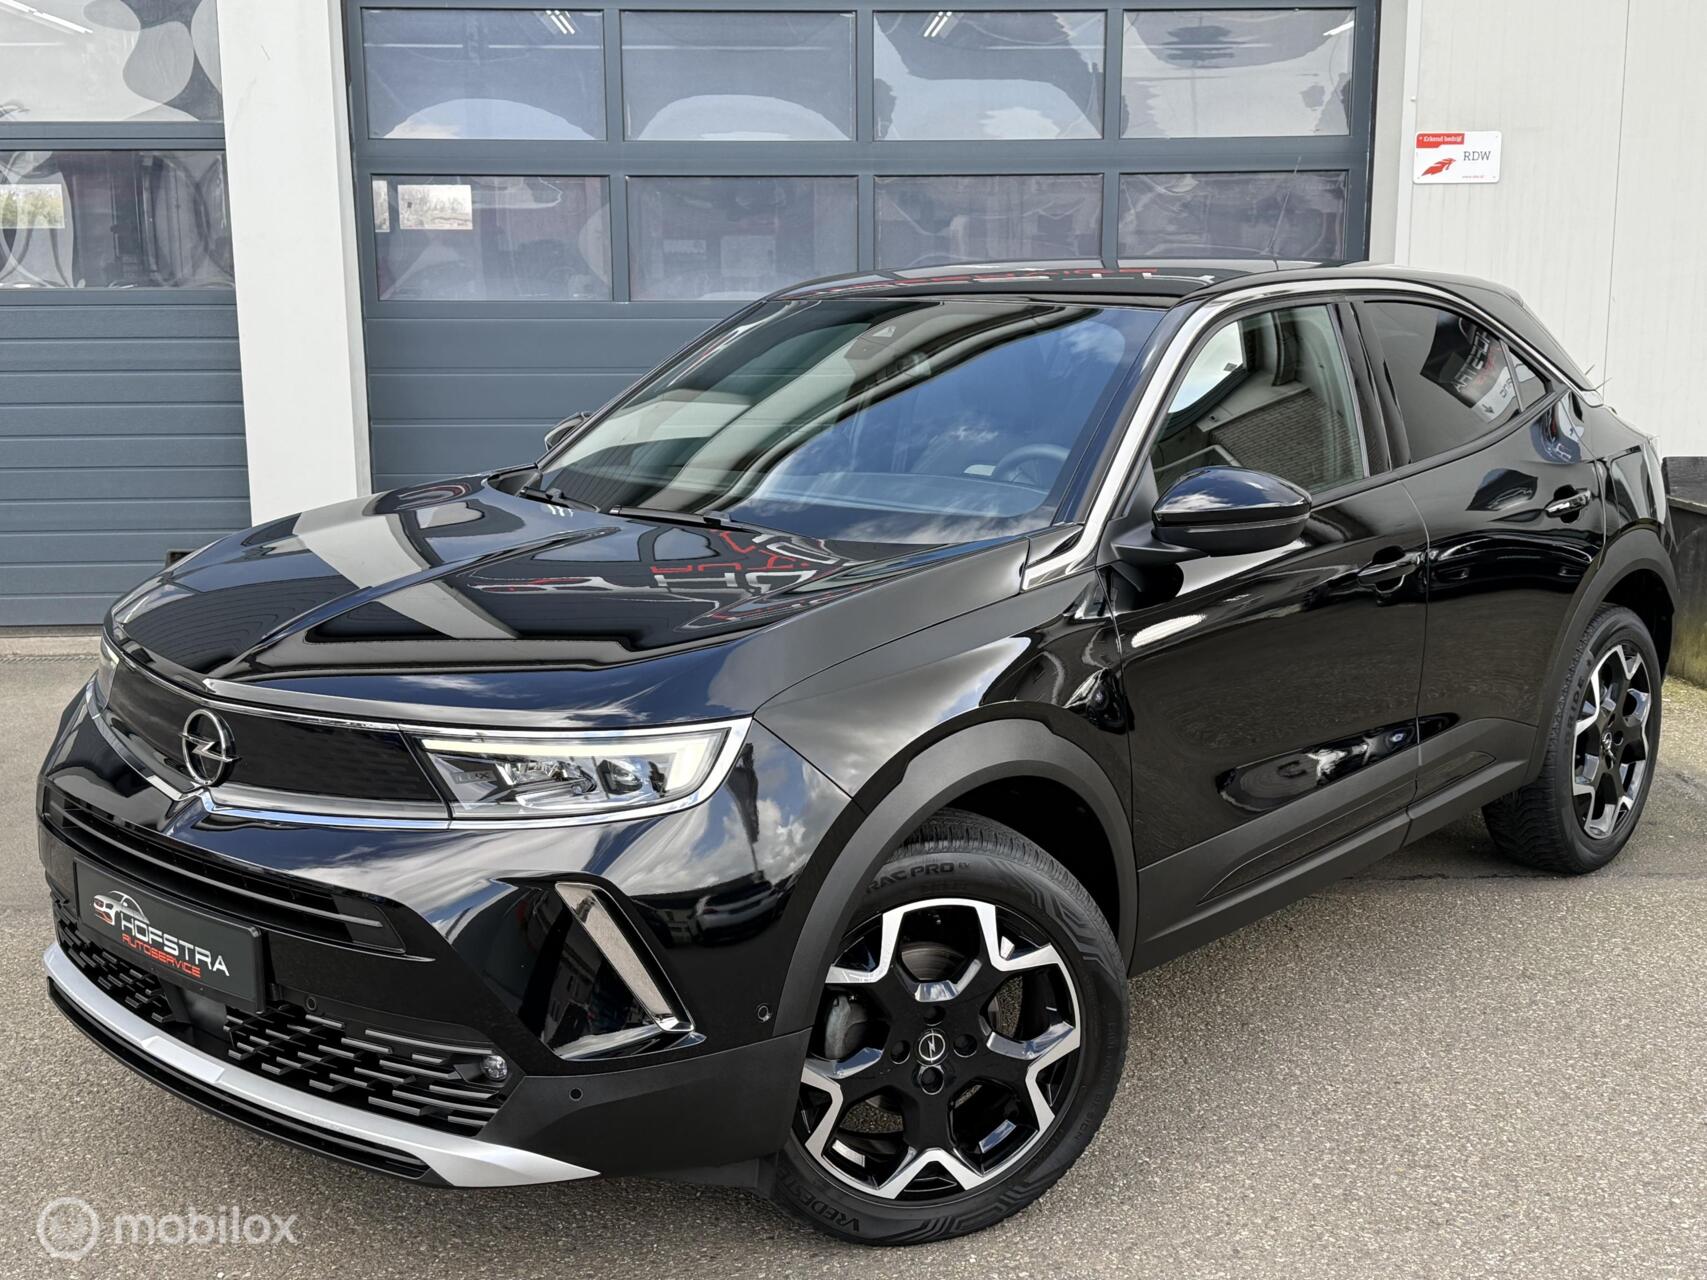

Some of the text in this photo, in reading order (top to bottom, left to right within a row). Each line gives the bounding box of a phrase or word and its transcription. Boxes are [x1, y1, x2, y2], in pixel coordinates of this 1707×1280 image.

[1463, 150, 1492, 161] RDW
[910, 862, 955, 879] PRO
[120, 911, 230, 977] HOFSTRA
[121, 933, 201, 978] AUTOSERVICE
